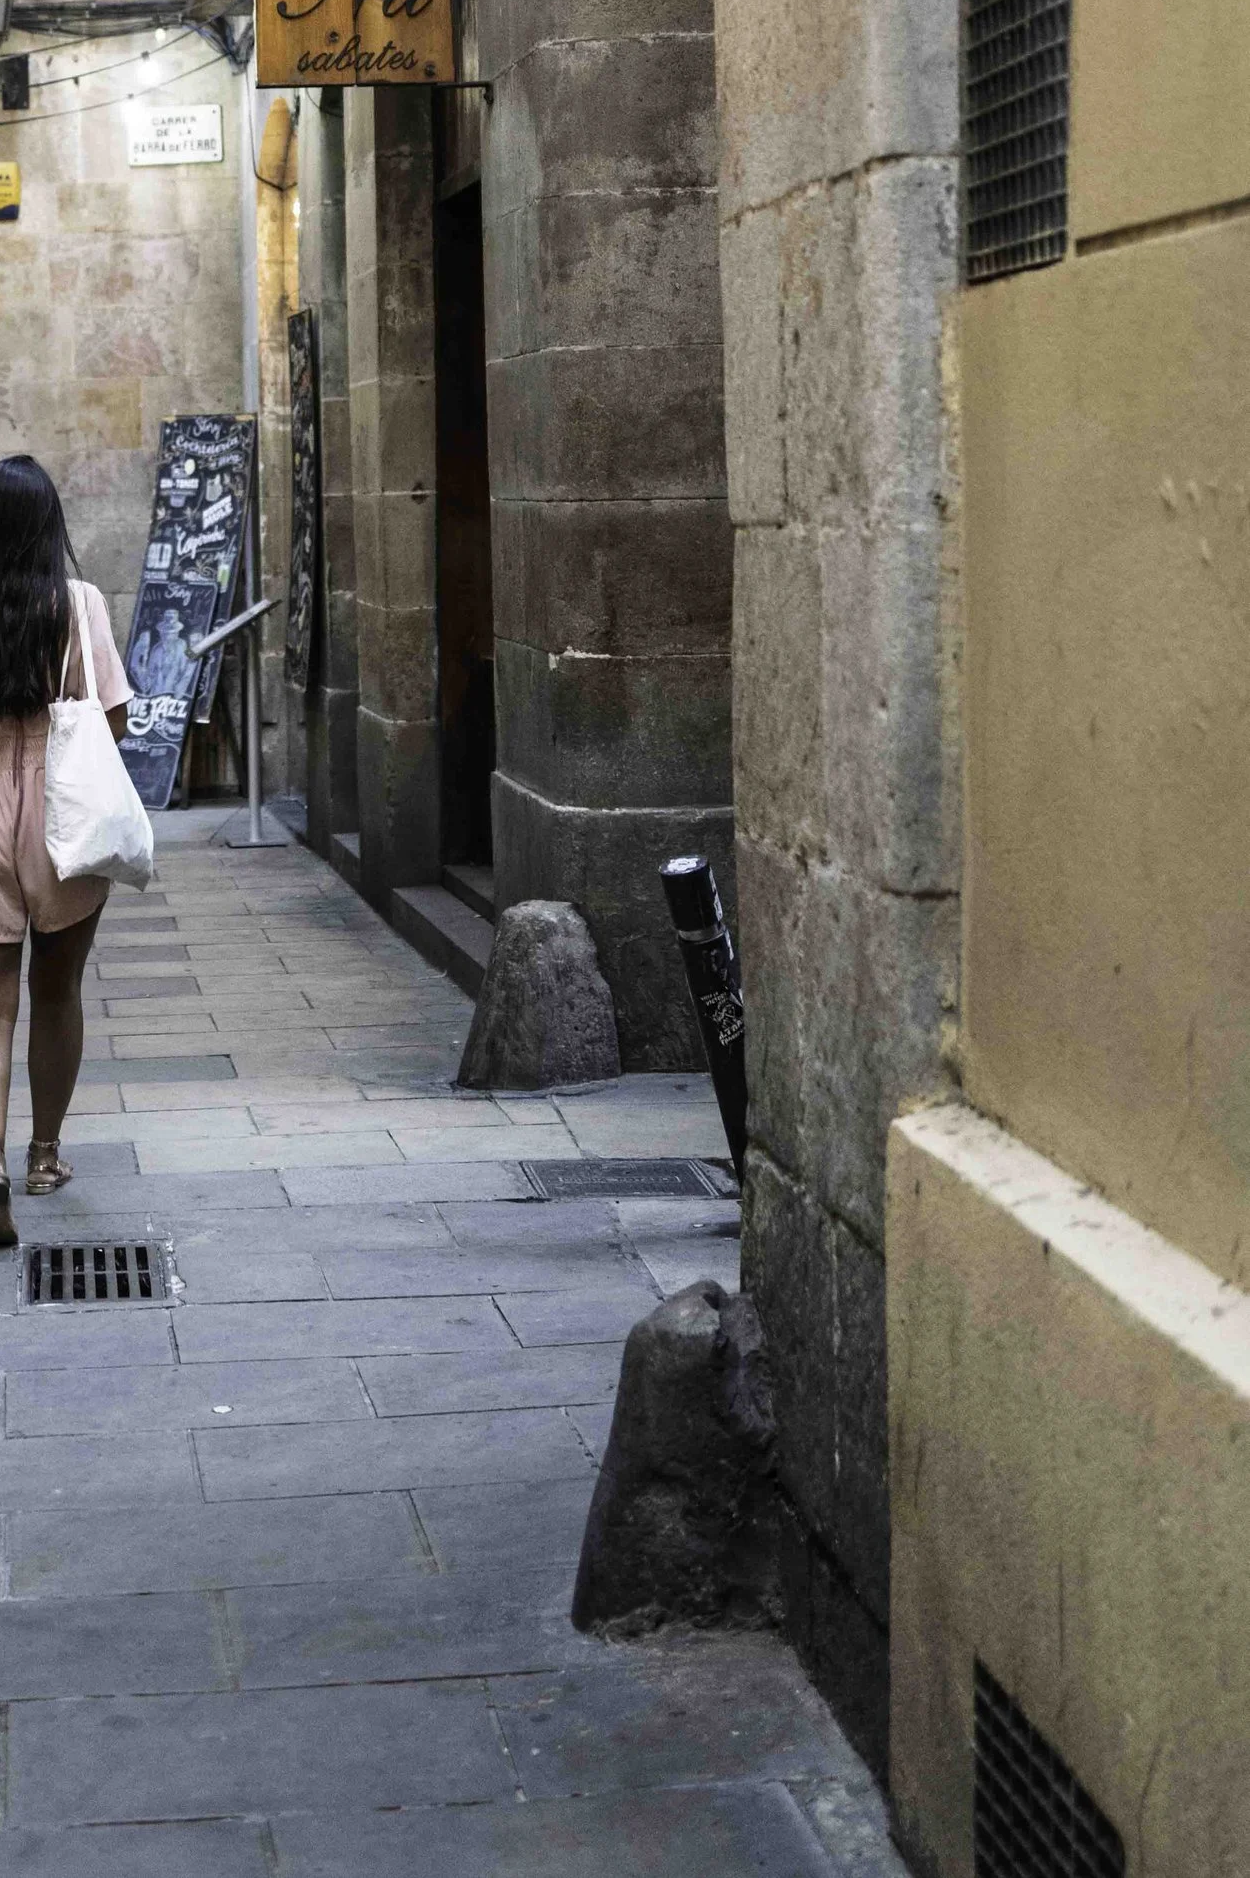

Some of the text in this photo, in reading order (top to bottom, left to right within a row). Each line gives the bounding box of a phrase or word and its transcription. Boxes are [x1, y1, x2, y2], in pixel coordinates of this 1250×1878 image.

[297, 33, 419, 73] sabates
[152, 116, 197, 126] CARRER
[155, 128, 169, 137] DE
[183, 138, 217, 151] FERRO
[127, 695, 188, 736] JAZZ
